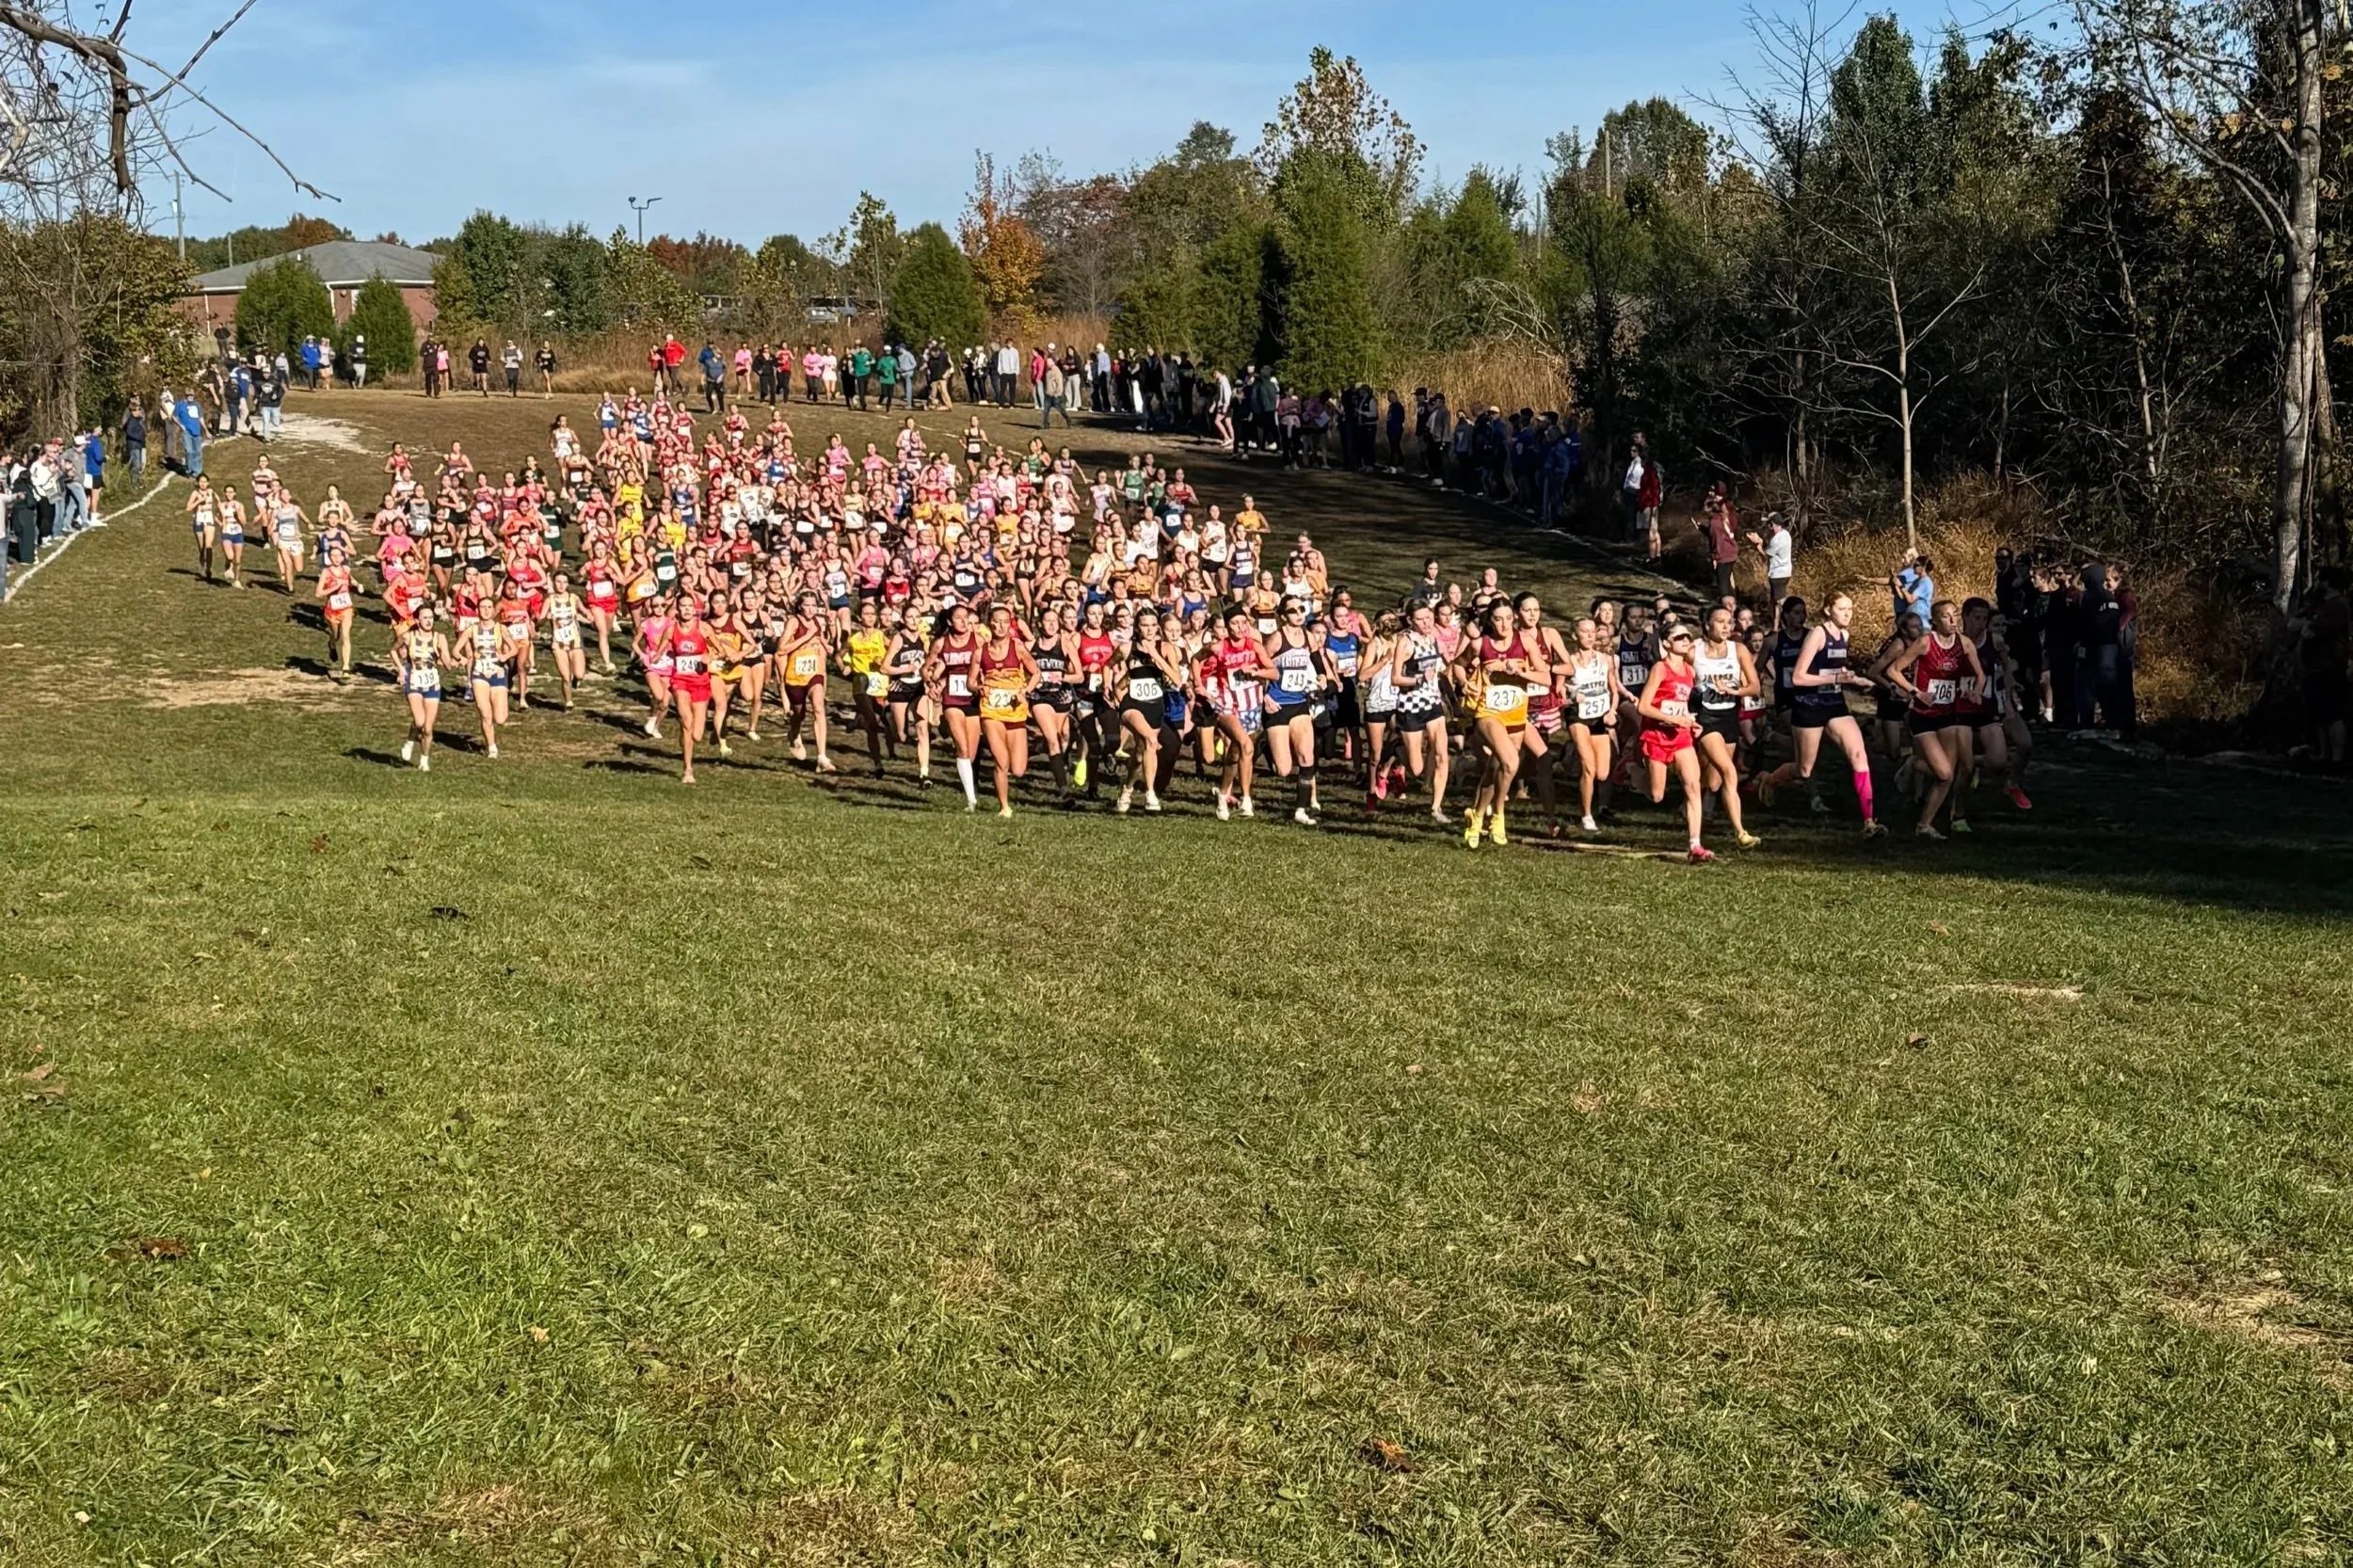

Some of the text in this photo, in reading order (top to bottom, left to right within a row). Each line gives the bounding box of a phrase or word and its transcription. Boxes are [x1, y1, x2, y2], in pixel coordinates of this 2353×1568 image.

[1136, 682, 1158, 697] 306
[1493, 689, 1516, 707] 237
[1934, 683, 1952, 700] 106
[1585, 698, 1605, 716] 257
